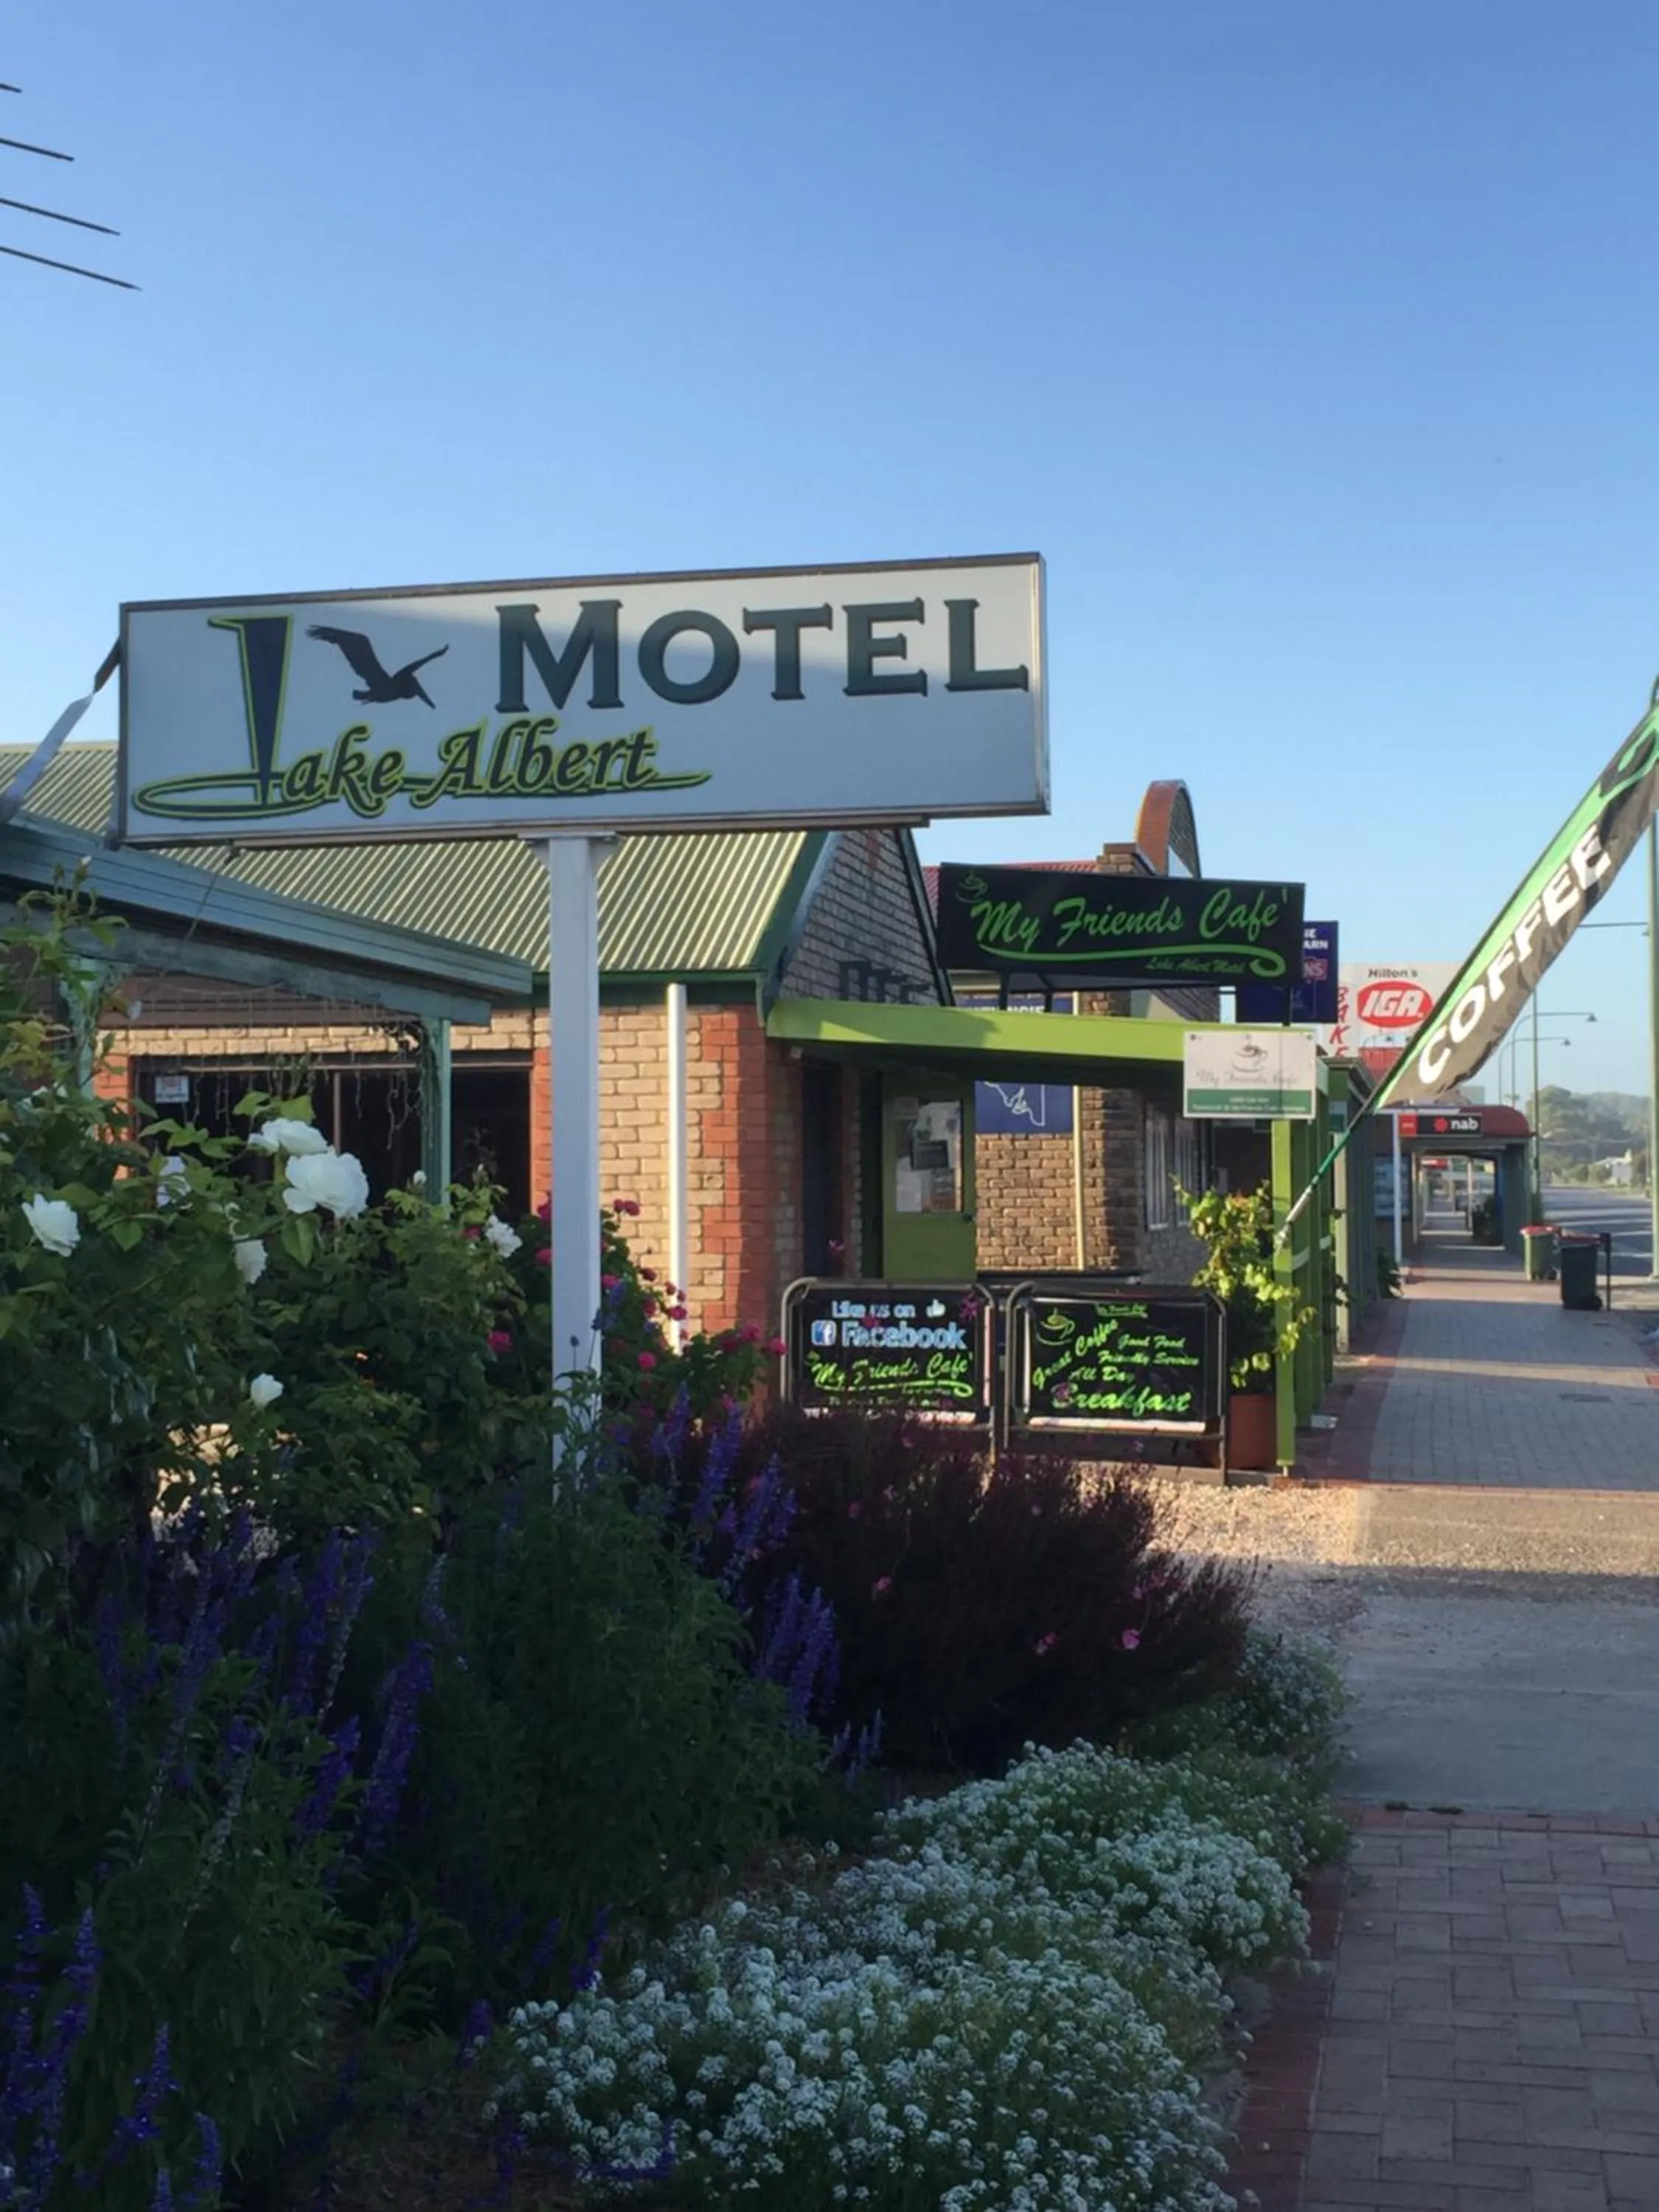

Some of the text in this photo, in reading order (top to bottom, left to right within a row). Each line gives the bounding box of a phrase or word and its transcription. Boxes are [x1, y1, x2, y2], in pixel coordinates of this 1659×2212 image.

[495, 596, 1029, 713] MOTEL
[133, 613, 662, 818] Lake Albert
[970, 900, 1039, 952] My
[1052, 896, 1183, 947] Friends
[1417, 824, 1613, 1085] COFFEE
[1368, 967, 1419, 979] Hilton's
[1361, 990, 1425, 1018] IGA
[1451, 1117, 1478, 1130] nab
[832, 1300, 916, 1318] Like us on
[841, 1321, 968, 1349] Facebook
[1075, 1318, 1119, 1357] Coffee
[812, 1363, 846, 1390] My
